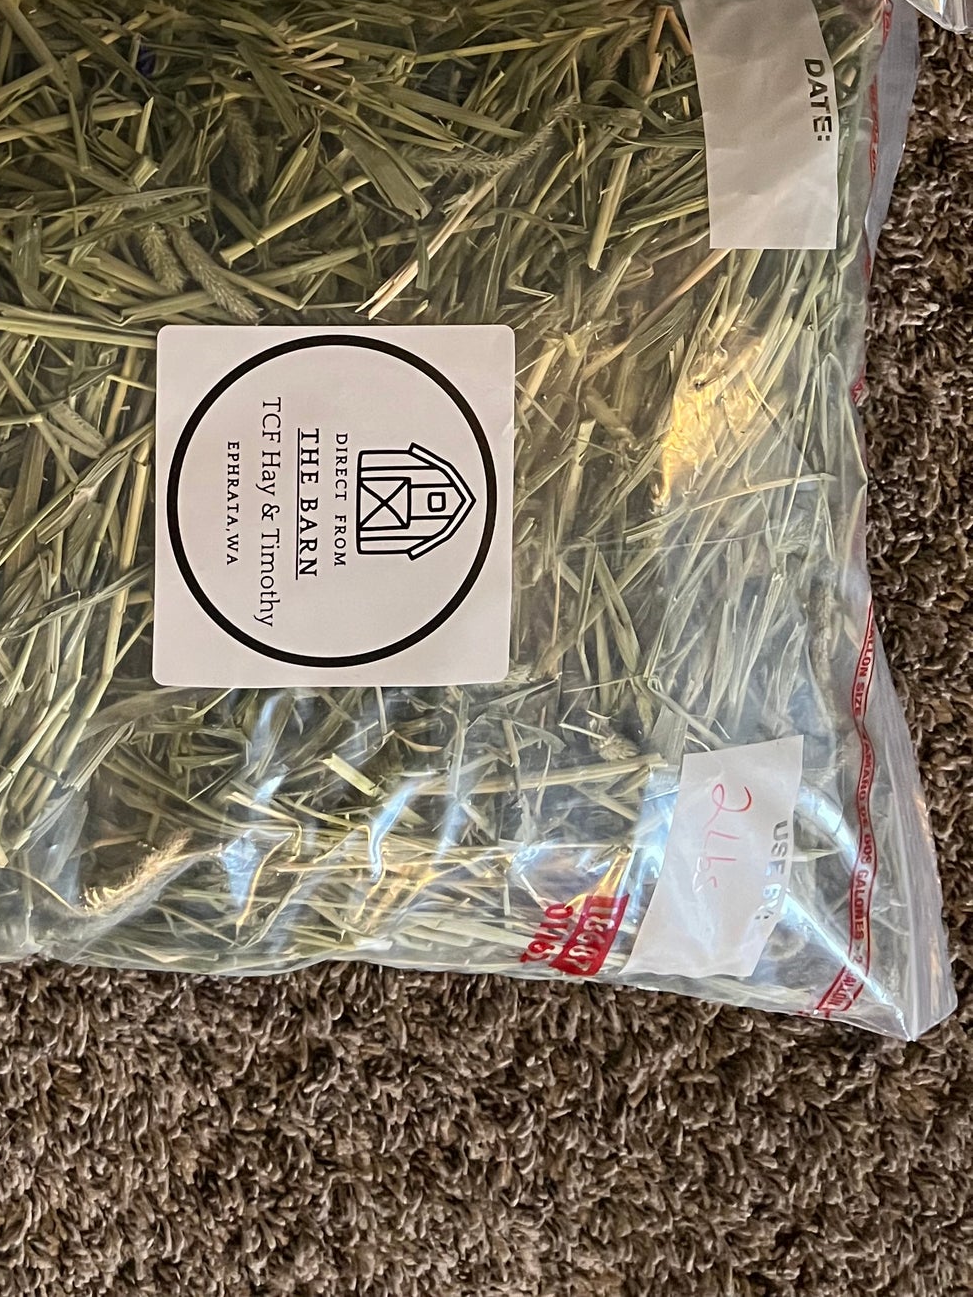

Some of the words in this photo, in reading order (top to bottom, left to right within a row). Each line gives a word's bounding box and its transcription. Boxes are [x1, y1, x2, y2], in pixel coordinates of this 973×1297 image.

[804, 58, 832, 142] DATE:
[262, 397, 281, 443] TCF
[255, 450, 281, 496] Hay
[299, 428, 319, 485] THE
[335, 433, 347, 500] DIRECT
[226, 441, 240, 566] EPHRATA,WA
[261, 503, 280, 521] &
[299, 498, 319, 577] BARN
[334, 514, 347, 567] FROM
[253, 528, 280, 627] Timothy
[858, 623, 875, 677] ALLON
[854, 682, 865, 717] SIZE
[706, 783, 753, 826] 2
[765, 819, 790, 876] USE
[854, 870, 867, 940] GALONES
[829, 970, 856, 1007] ALLON
